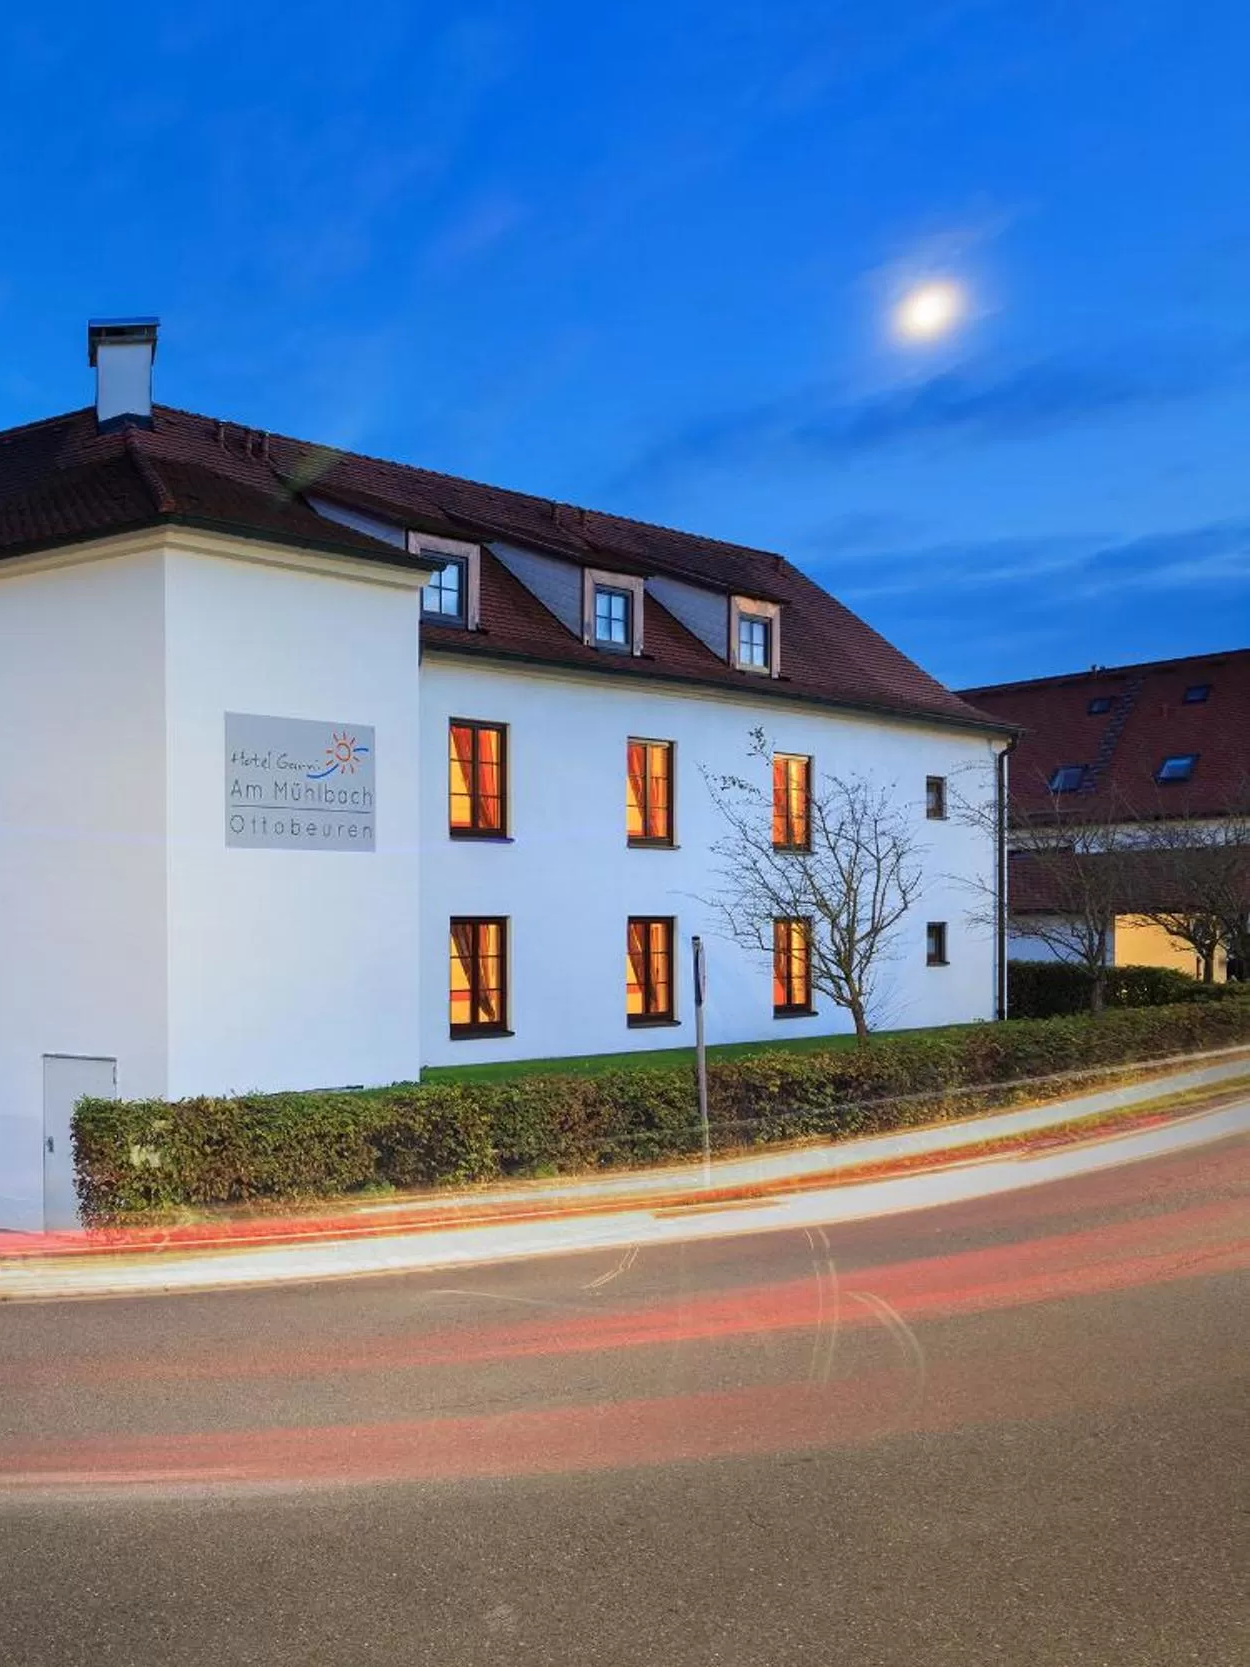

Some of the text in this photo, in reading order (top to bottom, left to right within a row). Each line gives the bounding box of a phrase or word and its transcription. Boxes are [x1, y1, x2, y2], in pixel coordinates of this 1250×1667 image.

[230, 751, 272, 769] Hotel
[230, 779, 374, 806] Am Mühlbach
[229, 814, 373, 839] Ottobeuren
